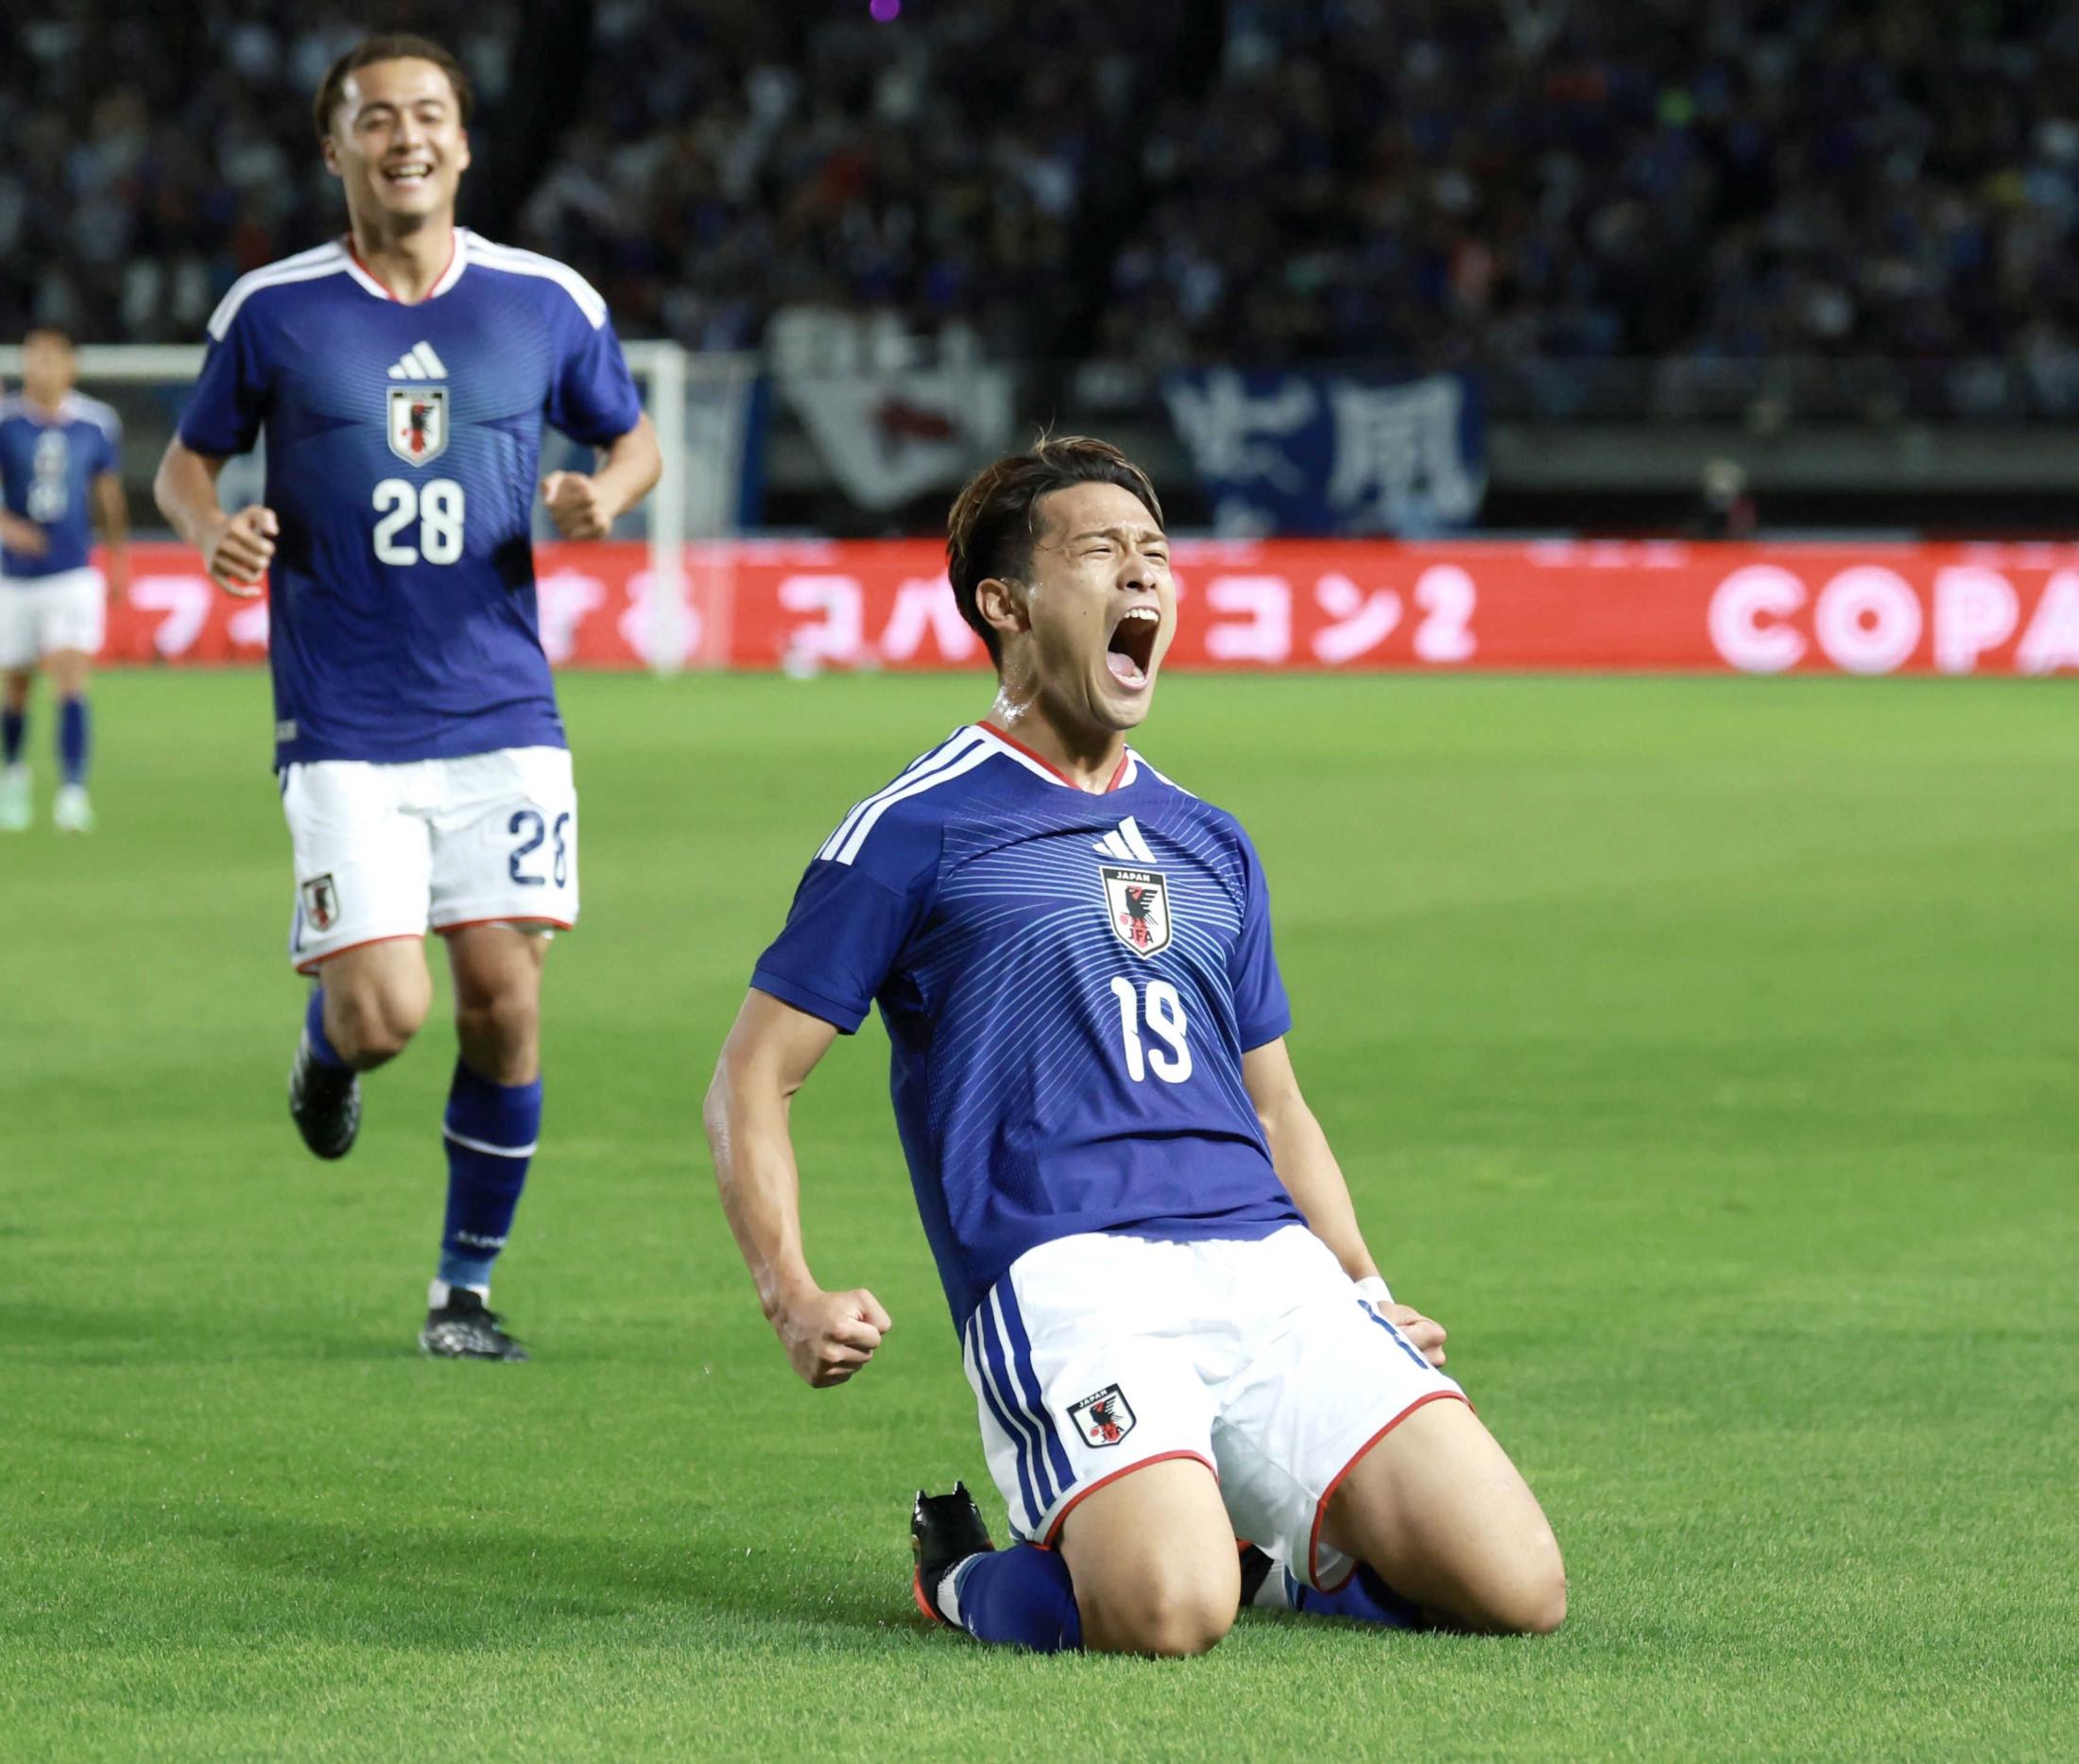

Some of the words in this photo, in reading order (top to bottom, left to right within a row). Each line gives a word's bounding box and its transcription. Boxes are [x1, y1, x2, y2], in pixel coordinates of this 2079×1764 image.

[372, 477, 465, 566] 28
[1116, 870, 1151, 882] JAPAN
[1127, 928, 1154, 944] JFA
[1110, 976, 1193, 1084] 19
[1078, 1389, 1108, 1409] JAPAN
